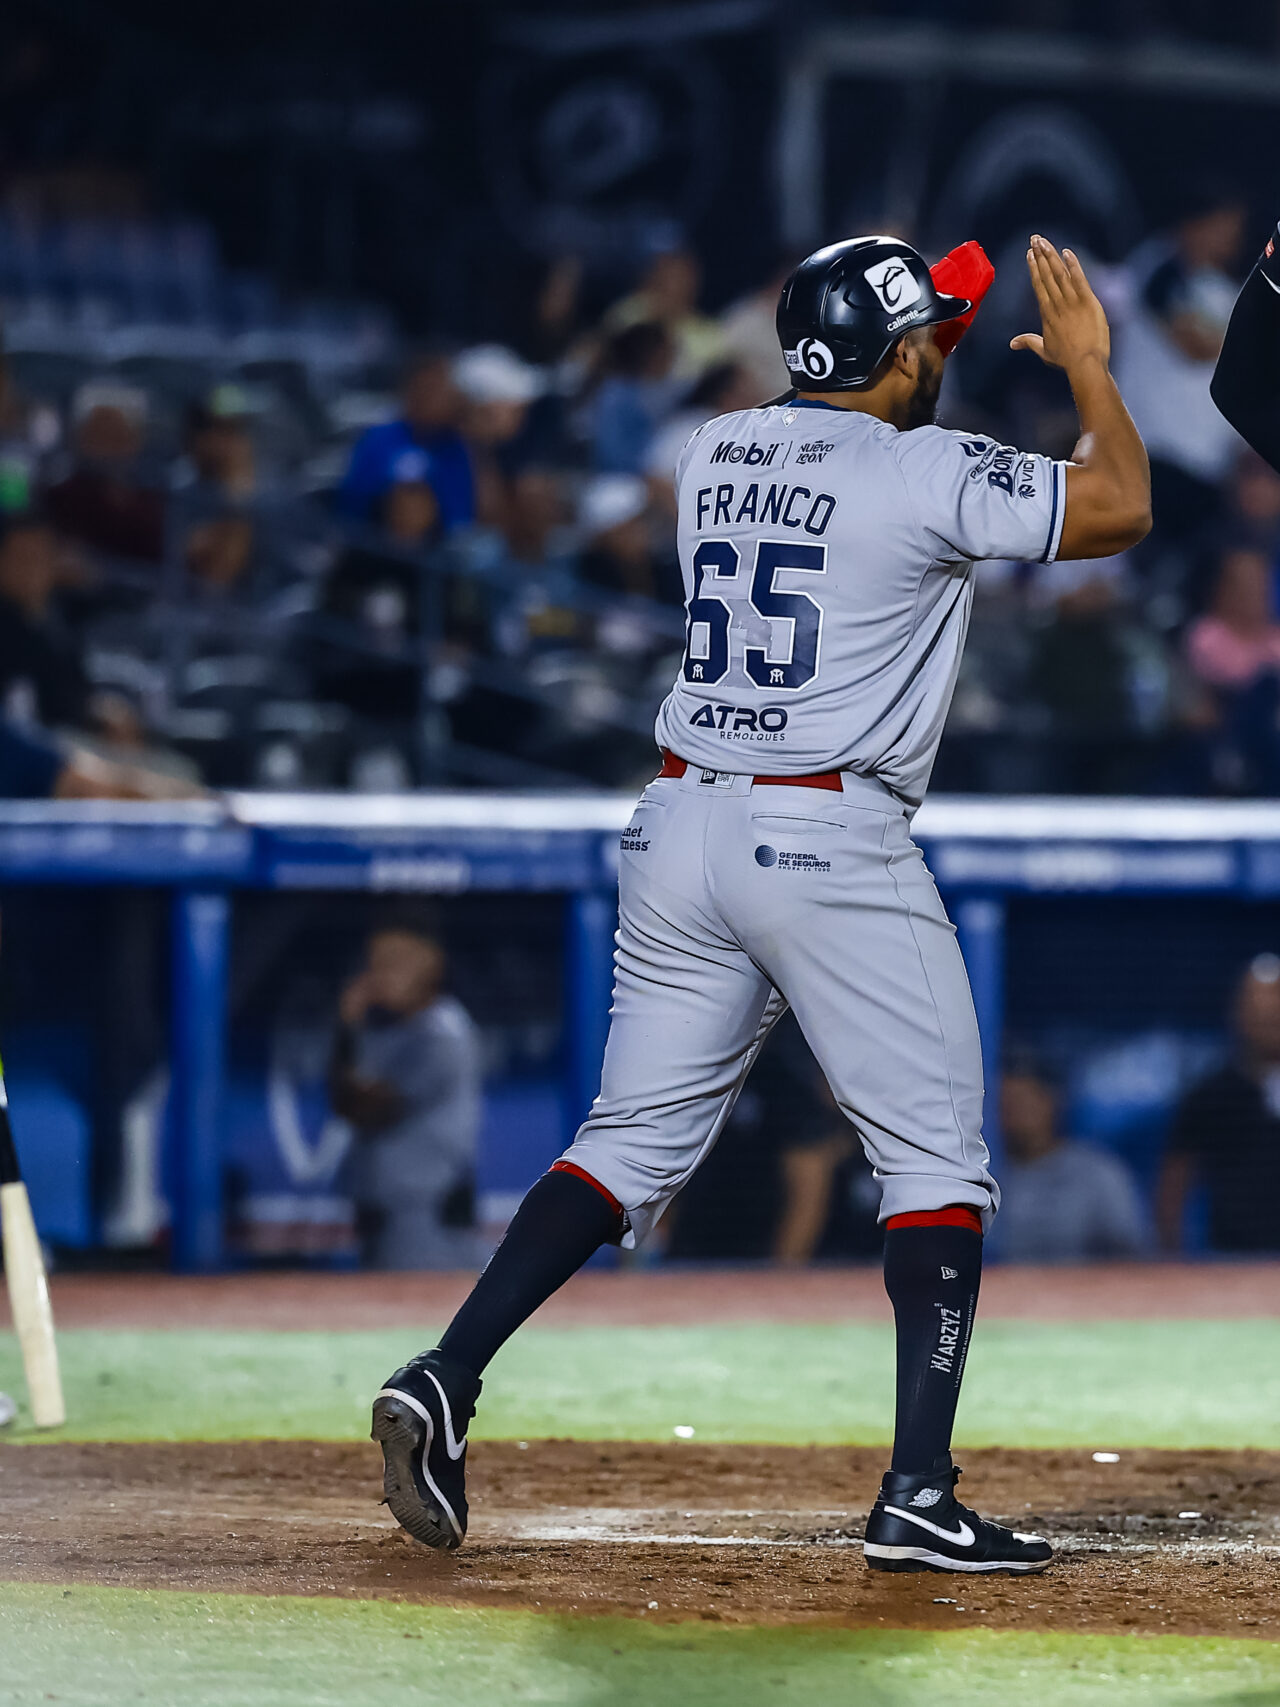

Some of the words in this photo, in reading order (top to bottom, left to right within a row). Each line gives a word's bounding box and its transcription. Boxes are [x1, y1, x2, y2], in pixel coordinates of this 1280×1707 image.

[886, 308, 921, 333] caliente
[801, 338, 828, 377] 6
[709, 440, 780, 467] Mobil
[694, 481, 839, 538] FRANCO
[684, 538, 830, 692] 65
[689, 703, 788, 733] ATRO
[718, 731, 787, 742] REMOLQUES
[778, 851, 819, 861] GENERAL
[778, 858, 790, 866] DE
[792, 859, 831, 868] SEGUROS
